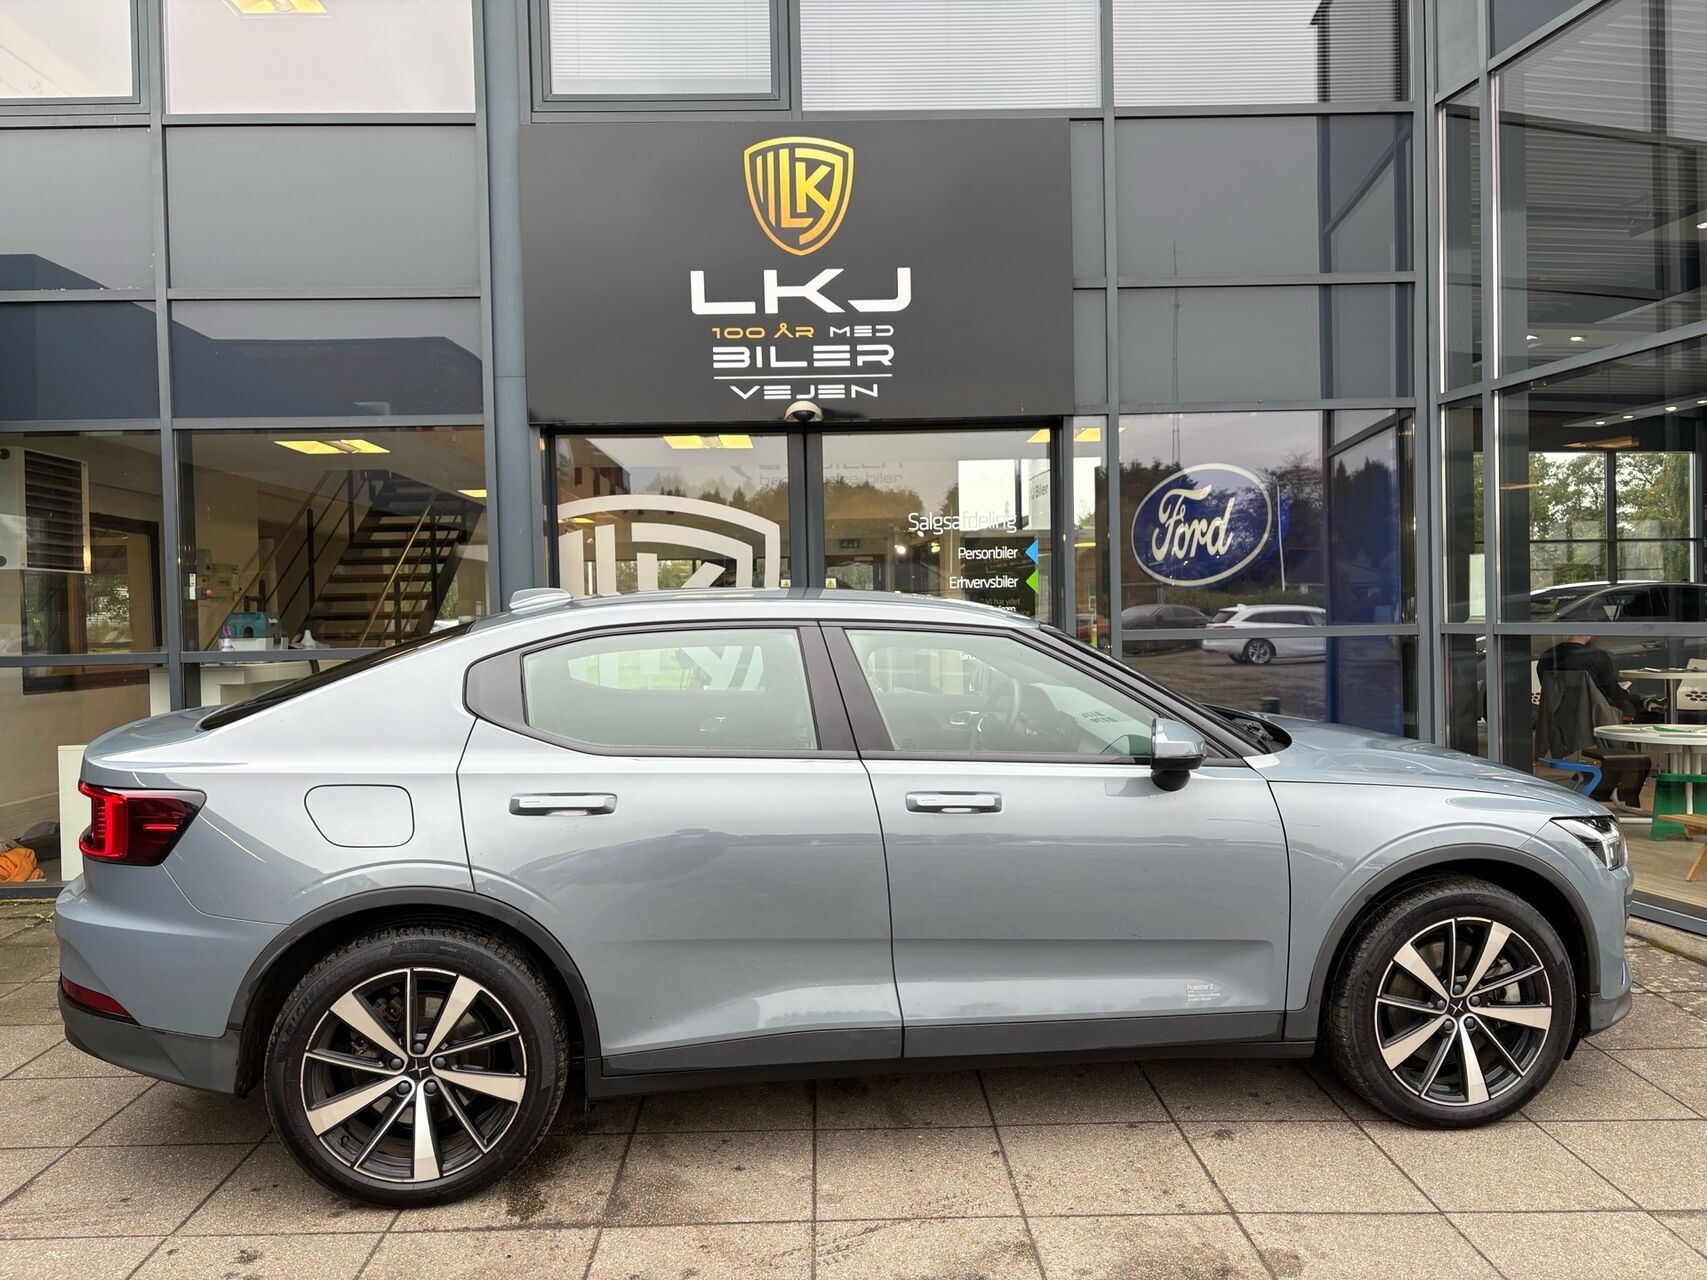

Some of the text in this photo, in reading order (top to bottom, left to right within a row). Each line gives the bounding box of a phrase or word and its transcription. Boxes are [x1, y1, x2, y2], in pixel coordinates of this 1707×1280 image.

[690, 267, 911, 314] LKJ
[712, 323, 894, 339] 100 ÅR MED
[713, 344, 895, 368] BILER
[730, 384, 878, 399] VEJEN
[908, 512, 1017, 535] Salgsafdeling
[1152, 484, 1235, 561] Ford
[958, 547, 1018, 560] Personbiler
[950, 576, 1019, 589] Erhvervsbiler
